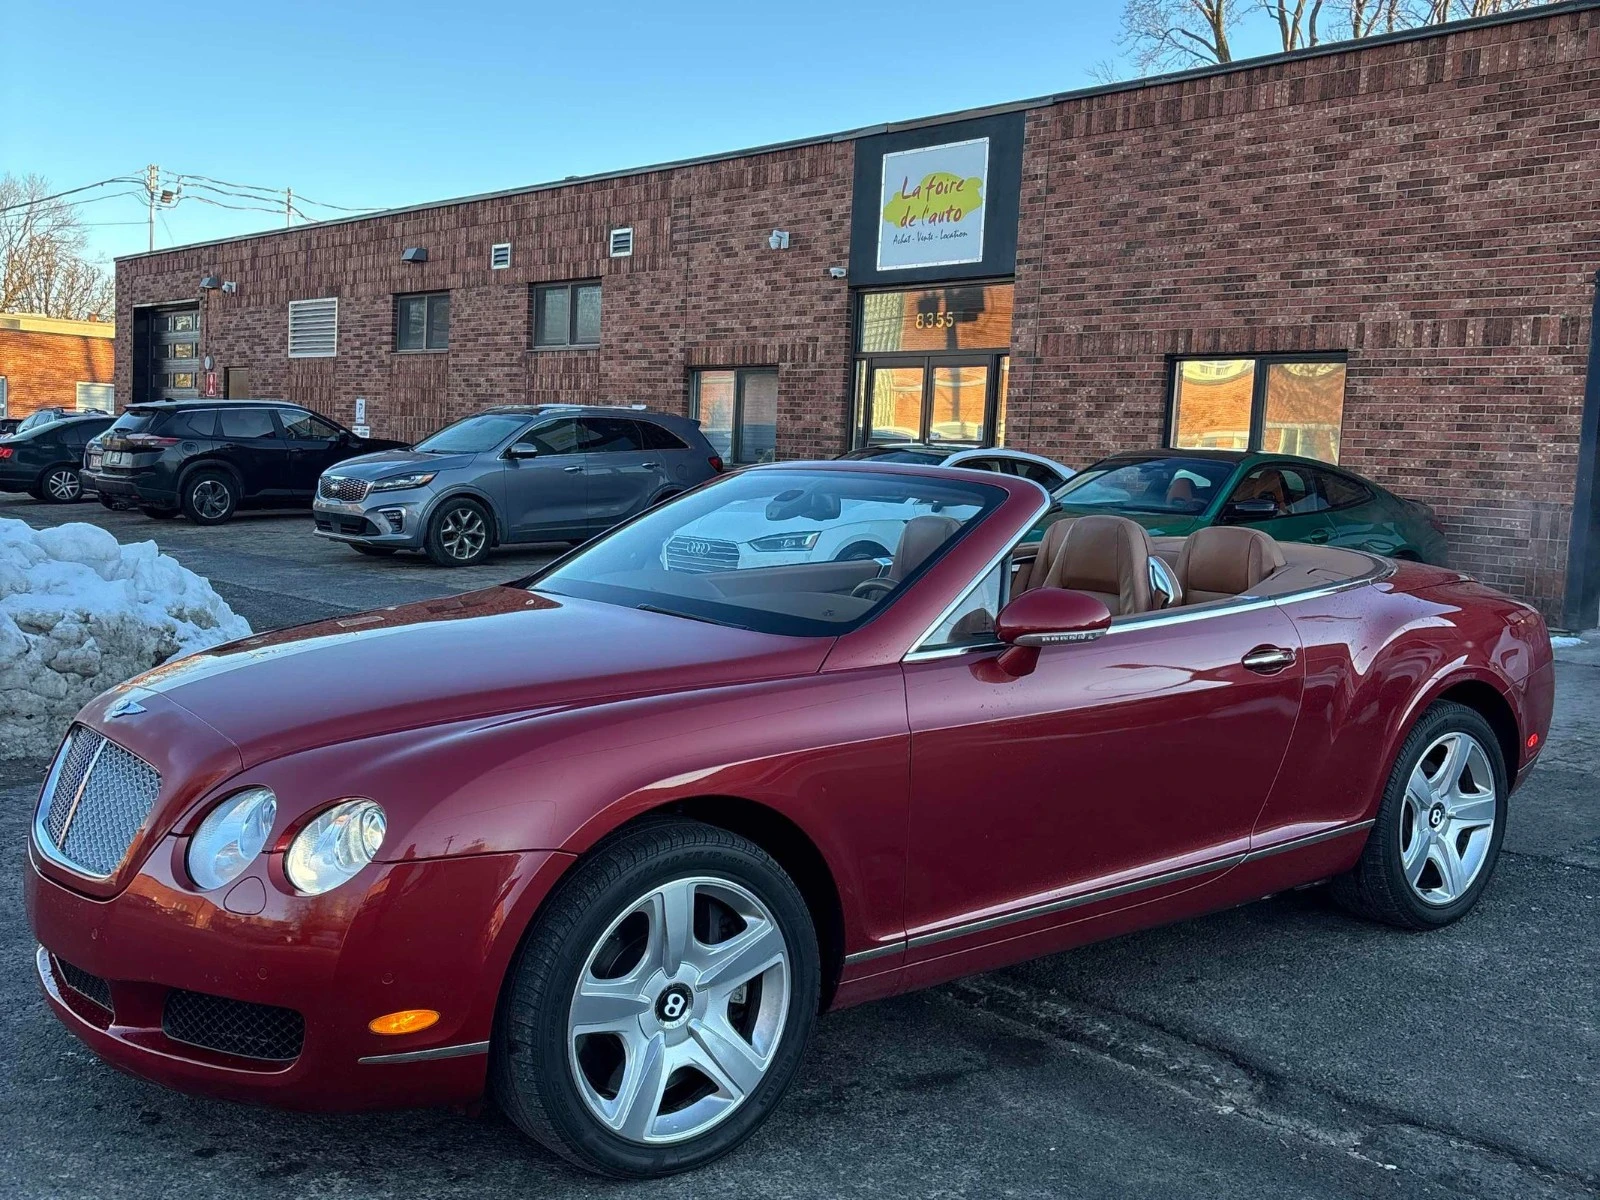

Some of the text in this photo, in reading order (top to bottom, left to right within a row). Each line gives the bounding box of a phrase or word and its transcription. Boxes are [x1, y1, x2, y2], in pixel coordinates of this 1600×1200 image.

[901, 175, 964, 202] La foire
[900, 204, 961, 228] de l'auto
[893, 234, 911, 245] Achat
[917, 231, 934, 242] Vente
[940, 229, 968, 240] Location
[915, 311, 954, 329] 8355
